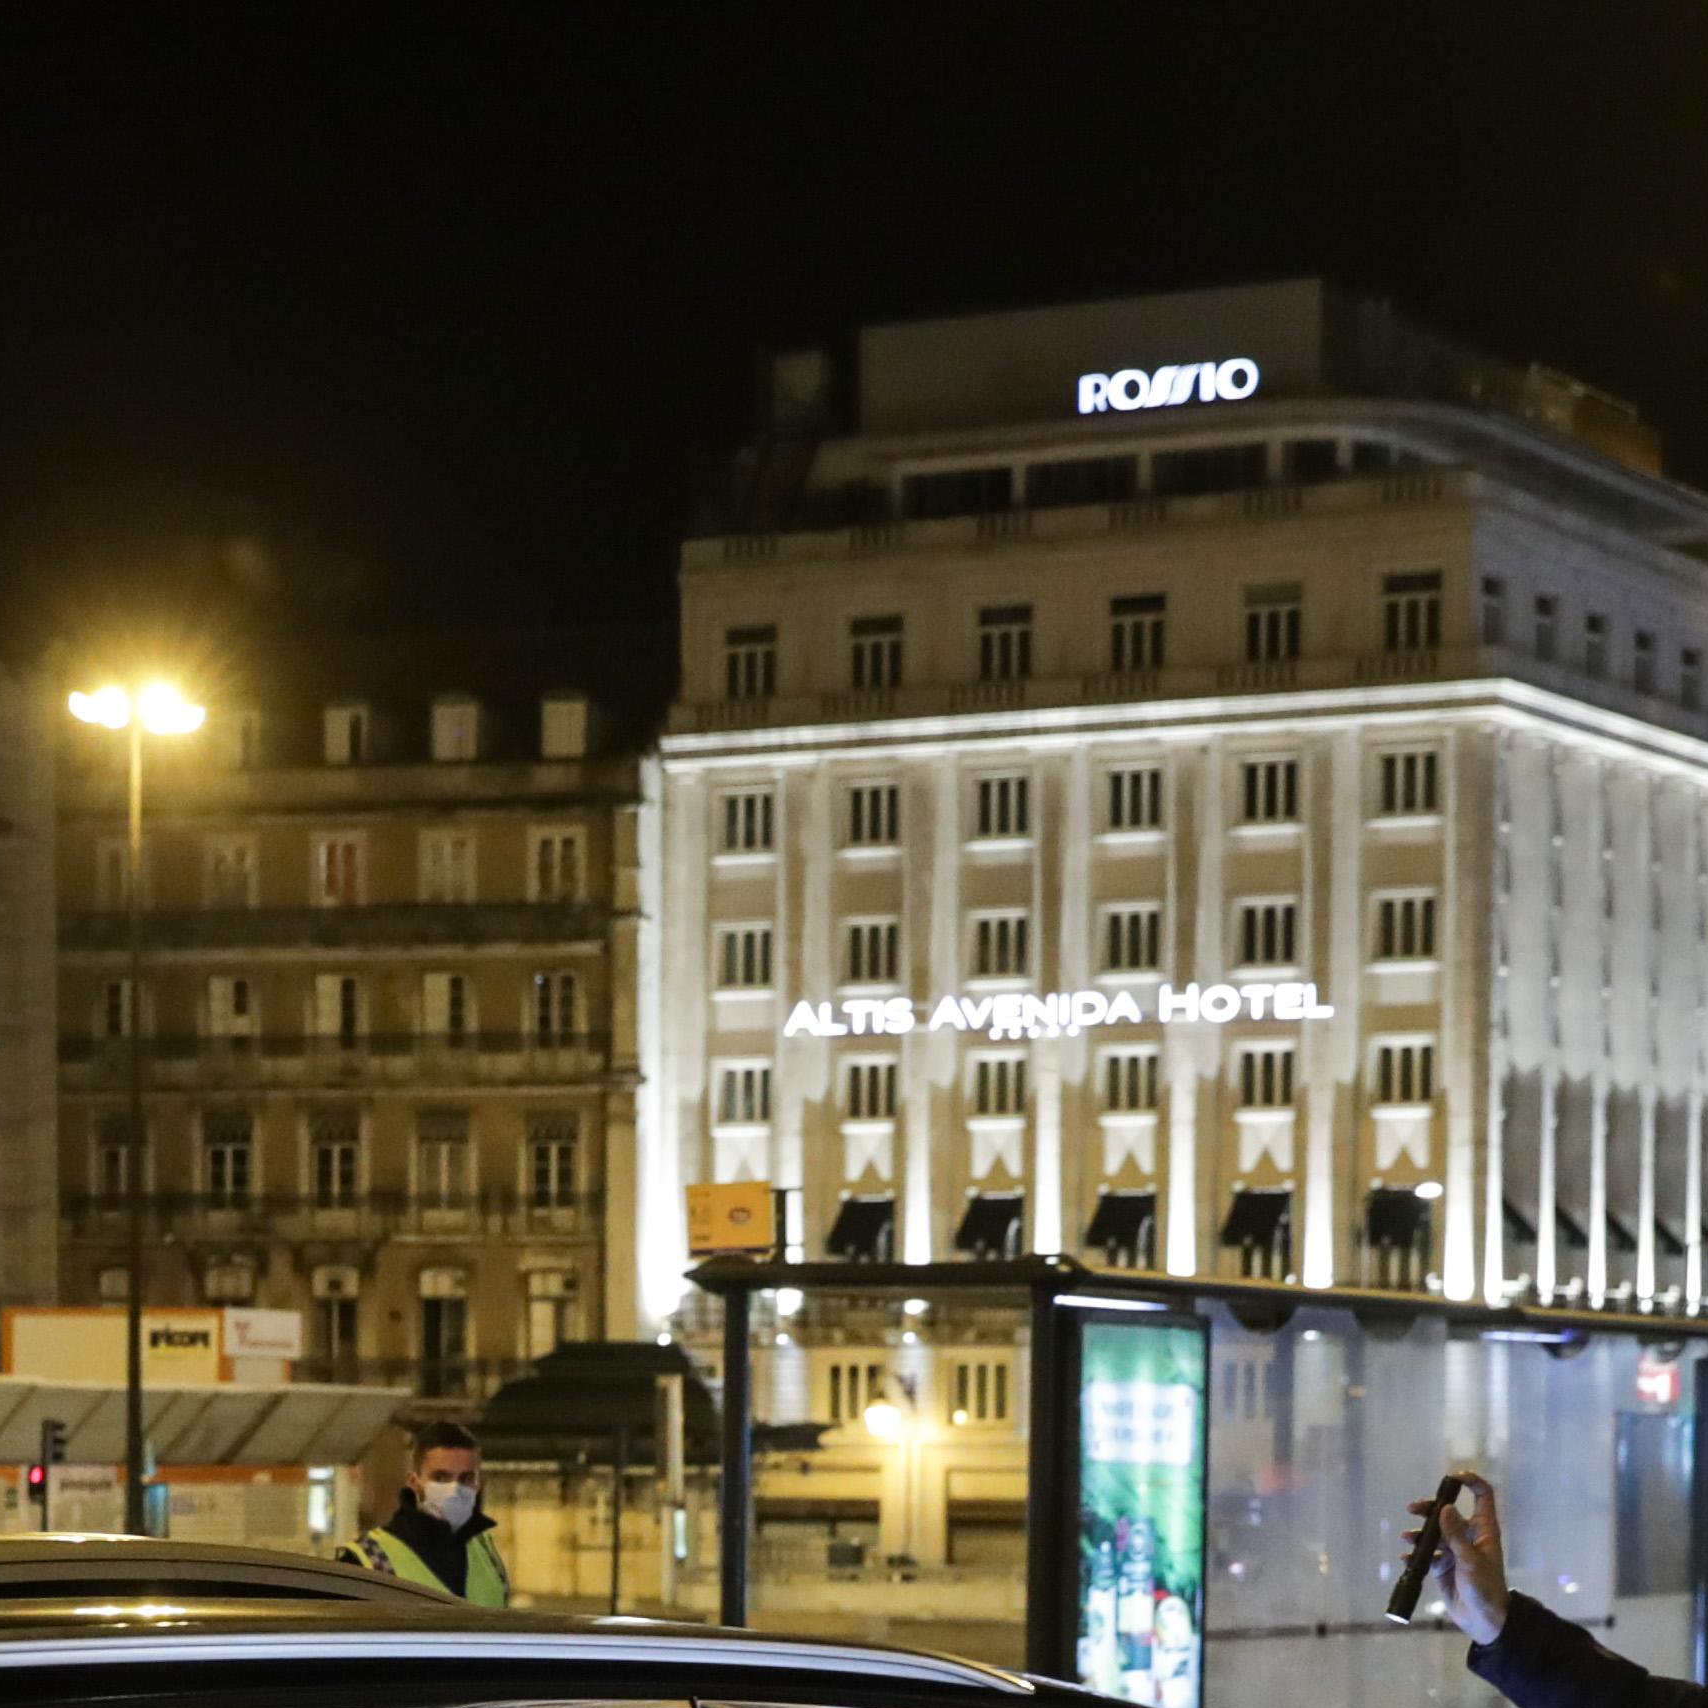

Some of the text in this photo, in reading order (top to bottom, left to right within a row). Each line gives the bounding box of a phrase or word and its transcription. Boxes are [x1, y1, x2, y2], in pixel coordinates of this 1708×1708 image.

[1078, 357, 1260, 414] ROSSIO
[784, 982, 1335, 1039] ALTIS AVENIDA HOTEL
